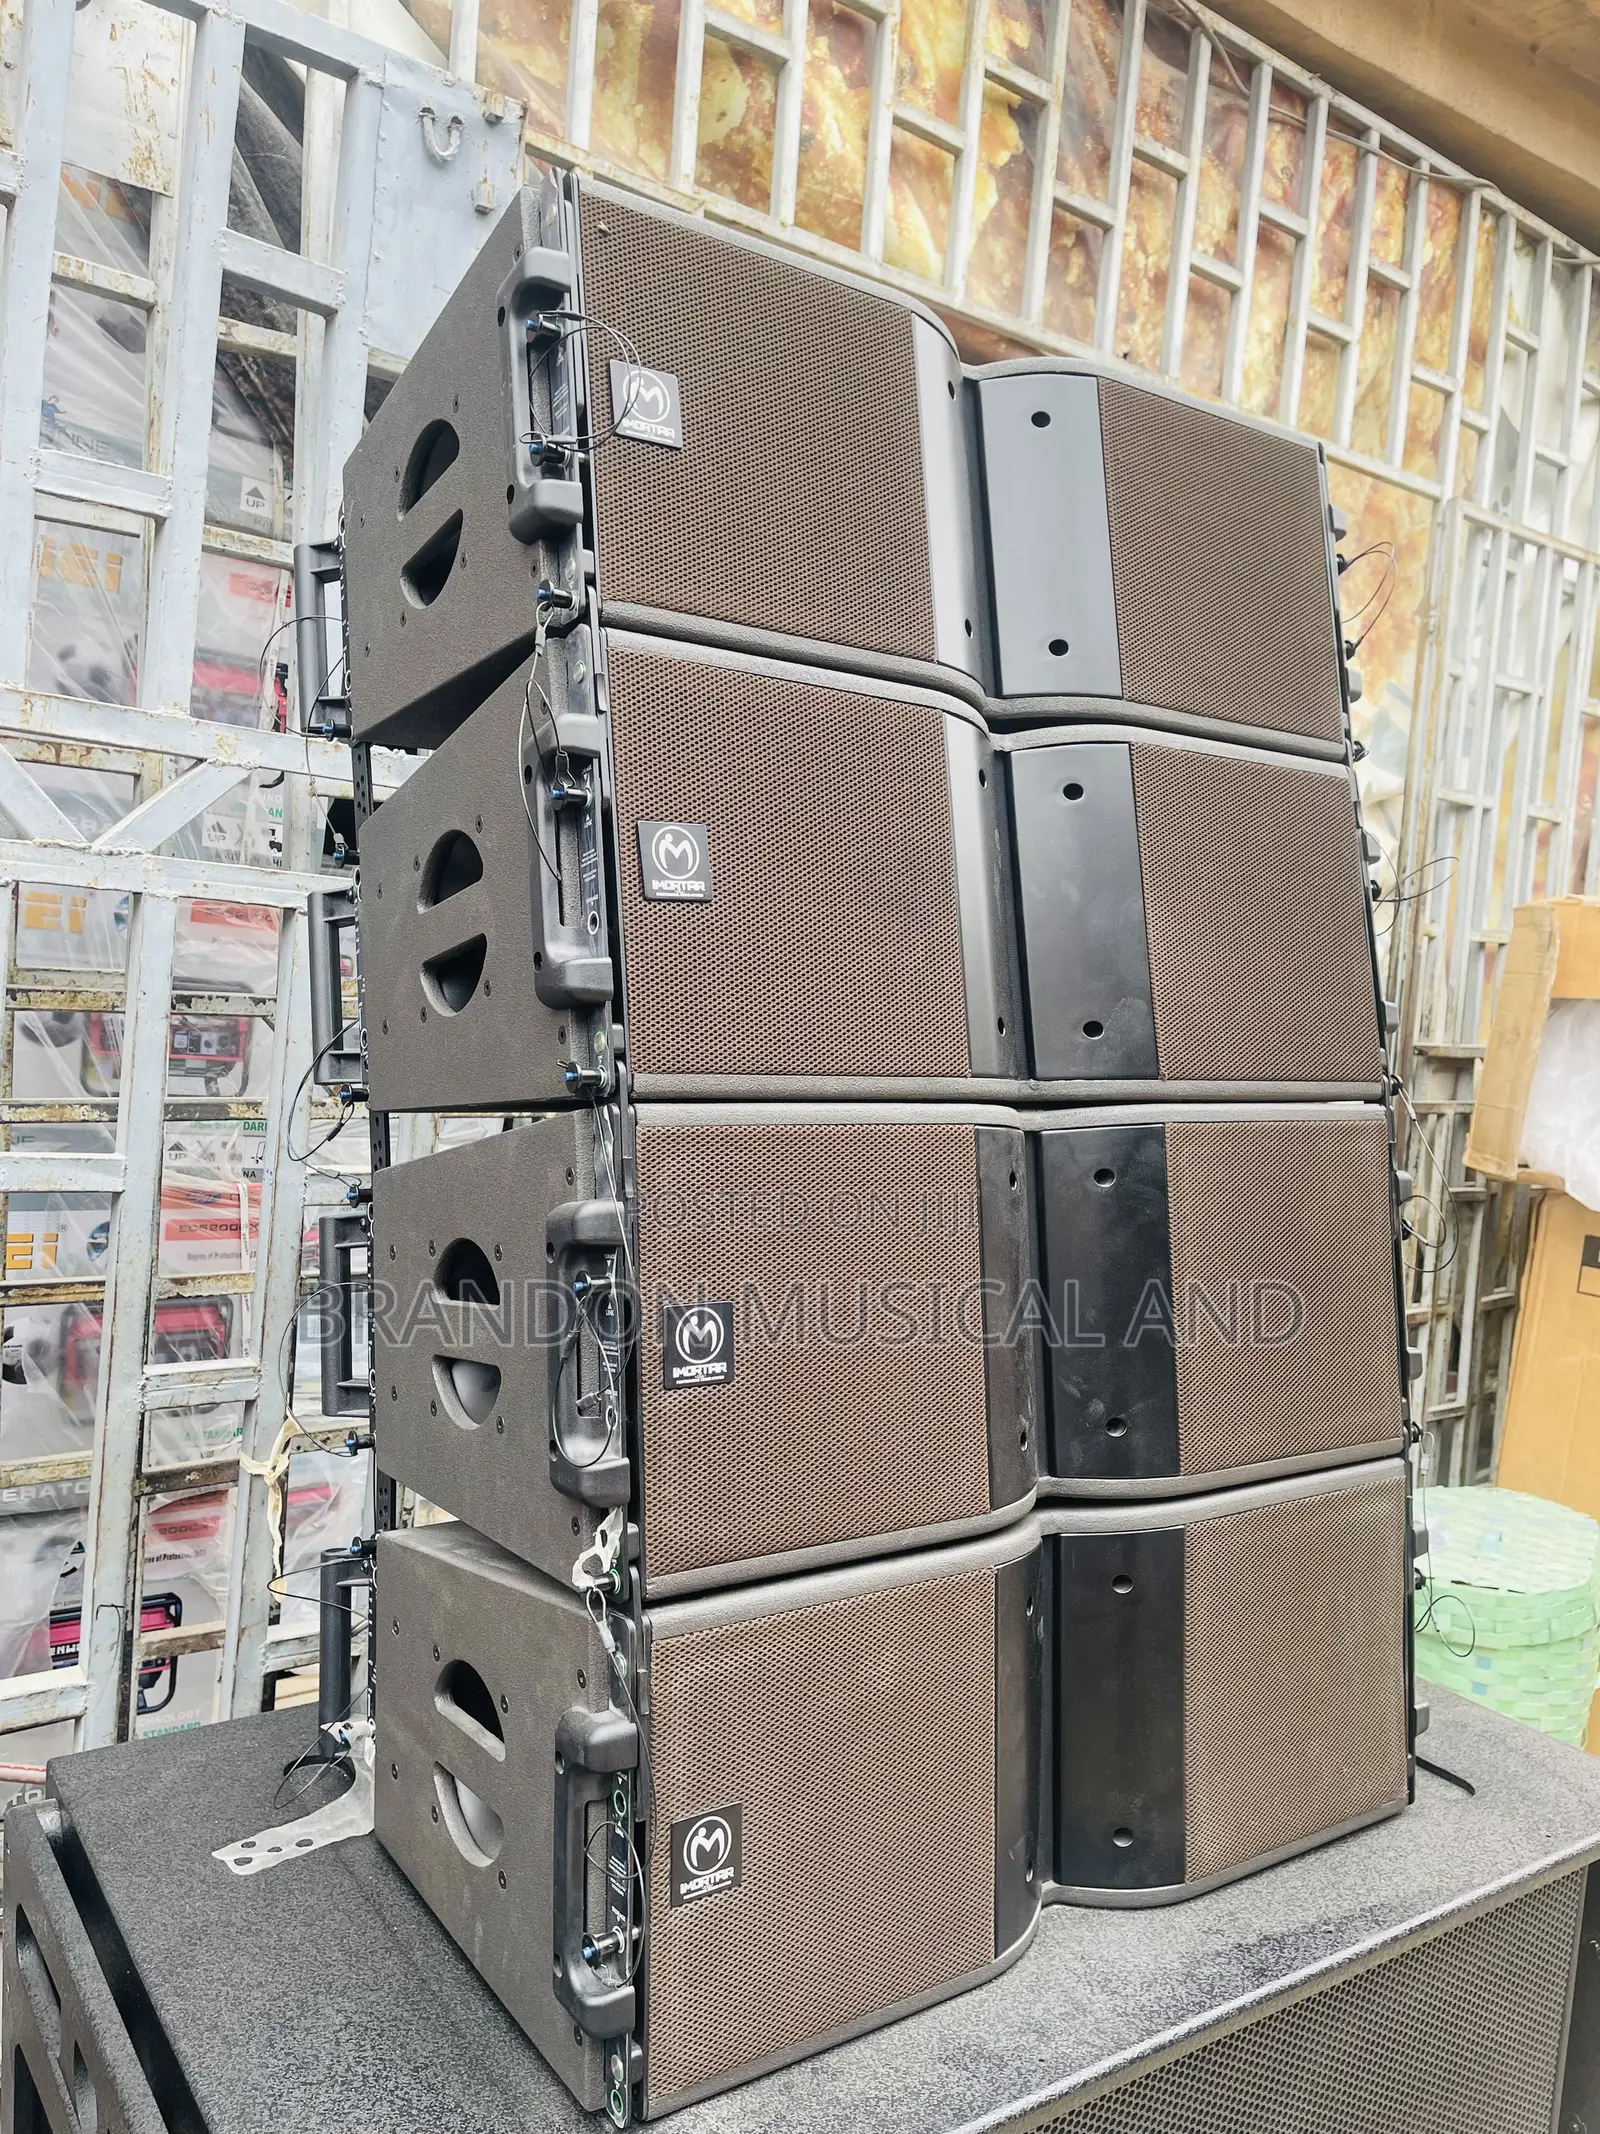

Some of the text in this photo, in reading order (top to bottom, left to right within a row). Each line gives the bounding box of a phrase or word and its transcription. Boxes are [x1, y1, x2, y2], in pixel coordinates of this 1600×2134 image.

[246, 497, 265, 508] UP
[652, 879, 706, 892] IMORTAR
[168, 1152, 187, 1161] UP
[672, 1362, 727, 1378] IMORTAR
[680, 1866, 735, 1894] IMORTAR
